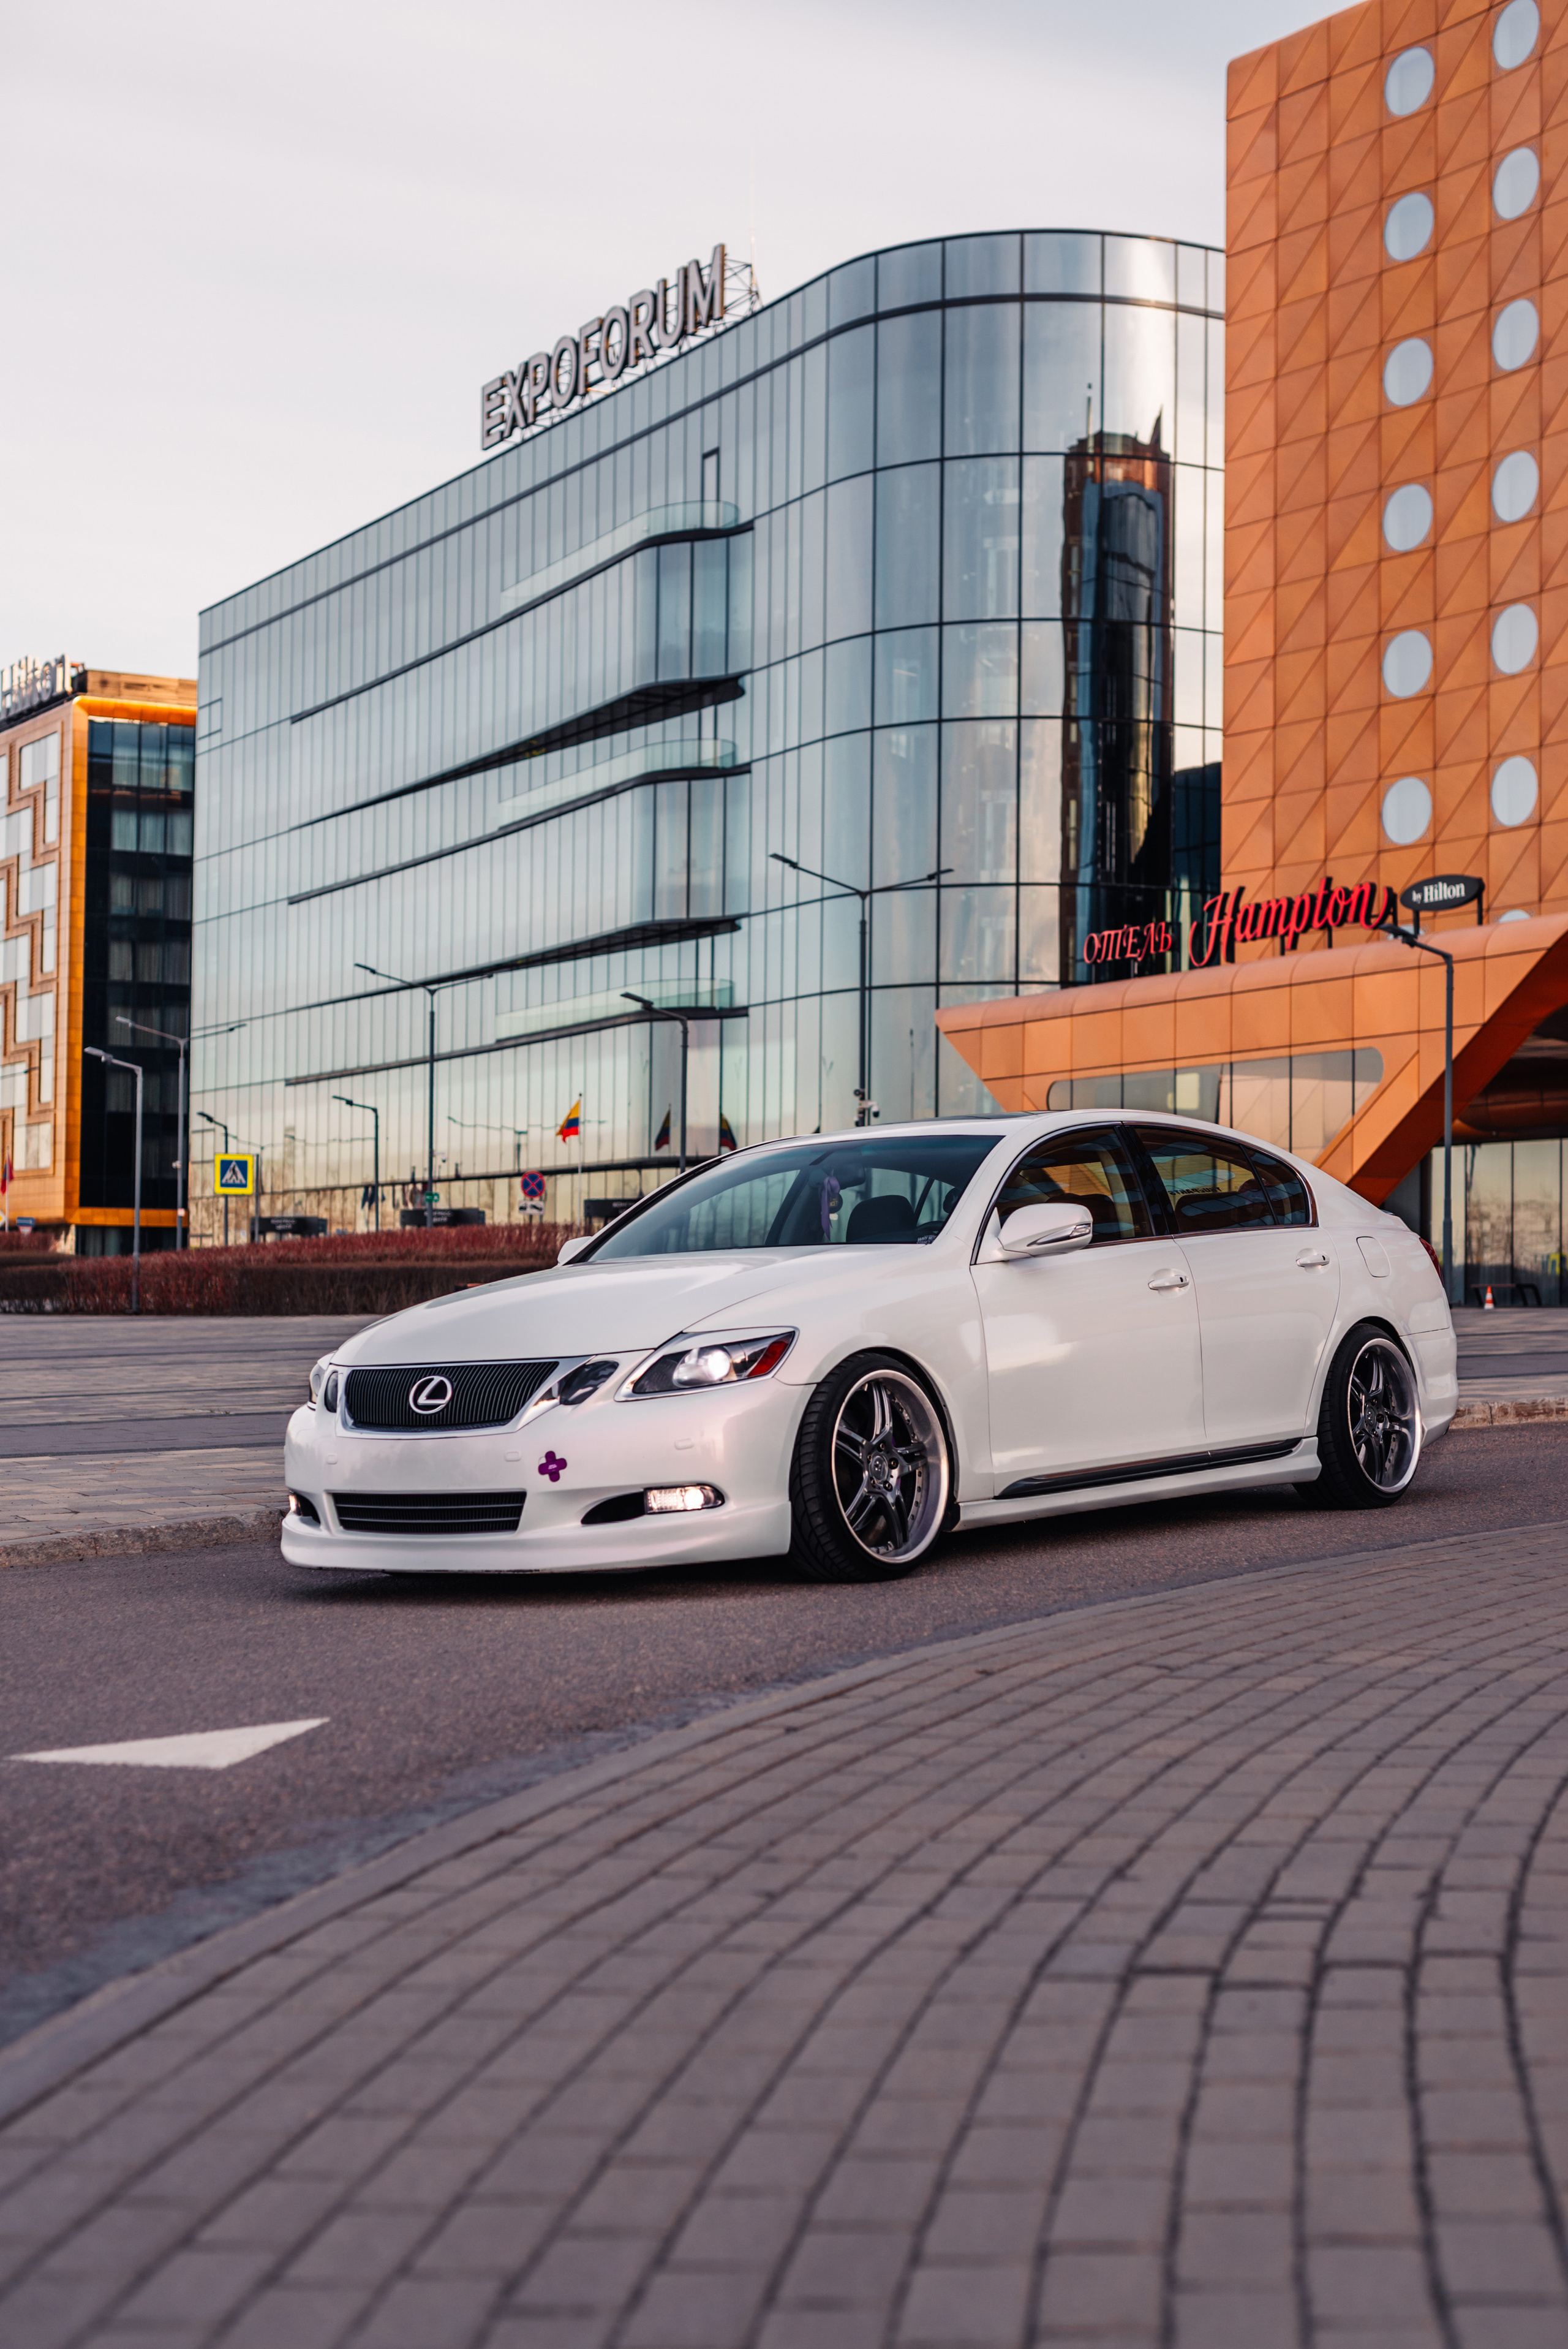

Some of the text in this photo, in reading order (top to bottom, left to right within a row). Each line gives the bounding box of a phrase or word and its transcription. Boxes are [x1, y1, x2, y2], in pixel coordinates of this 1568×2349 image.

[482, 243, 725, 450] EXPOFORUM
[1189, 877, 1389, 967] Hampton
[1412, 882, 1465, 904] by Hilton
[1084, 921, 1172, 964] ОТЕЛЬ
